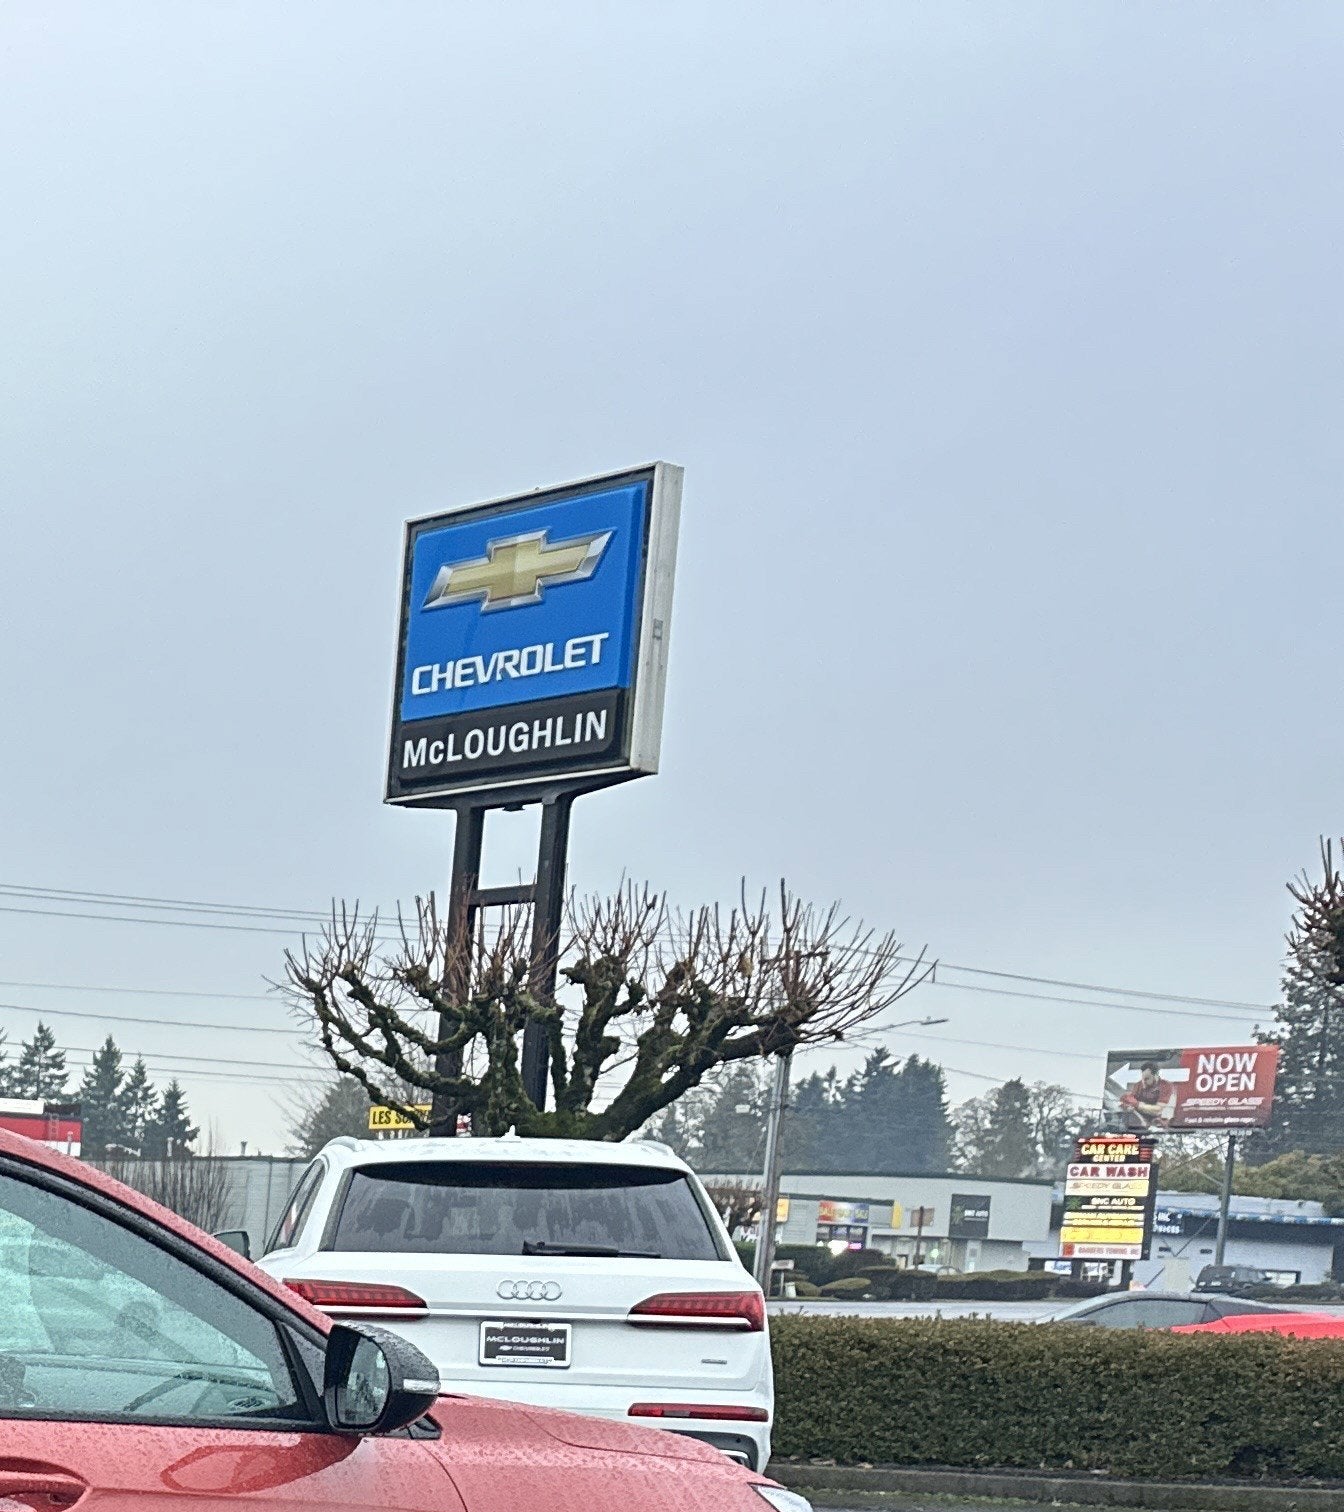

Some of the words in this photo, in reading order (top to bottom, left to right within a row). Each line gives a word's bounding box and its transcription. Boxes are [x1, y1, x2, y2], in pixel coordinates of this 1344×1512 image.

[412, 632, 609, 696] CHEVROLET
[402, 709, 607, 769] McLOUGHLIN
[1197, 1053, 1258, 1074] NOW
[1195, 1073, 1257, 1092] OPEN
[372, 1110, 392, 1125] LES
[1080, 1143, 1105, 1155] CAR
[1107, 1143, 1140, 1155] CARE
[1092, 1154, 1126, 1162] CENTER
[1070, 1166, 1100, 1177] CAR
[1106, 1166, 1148, 1177] WASH
[1111, 1197, 1137, 1206] AUTO
